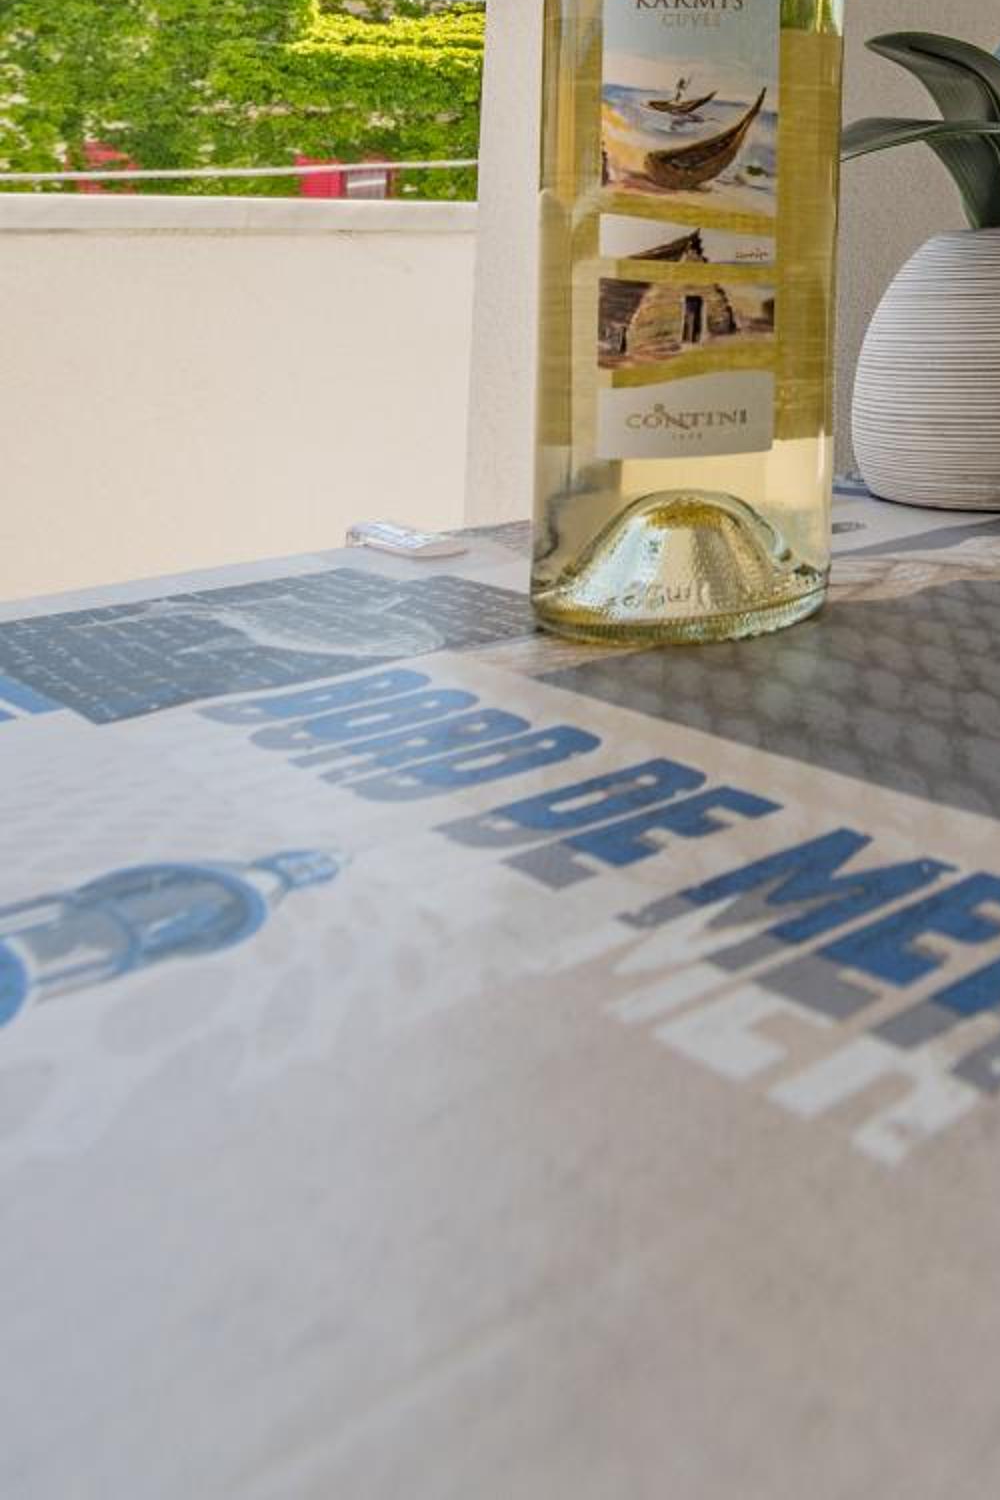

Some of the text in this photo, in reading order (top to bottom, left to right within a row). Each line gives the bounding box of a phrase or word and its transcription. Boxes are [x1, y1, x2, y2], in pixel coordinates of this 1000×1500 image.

[625, 408, 748, 431] CONTINI
[194, 667, 602, 802] BORD
[431, 756, 784, 891] DE
